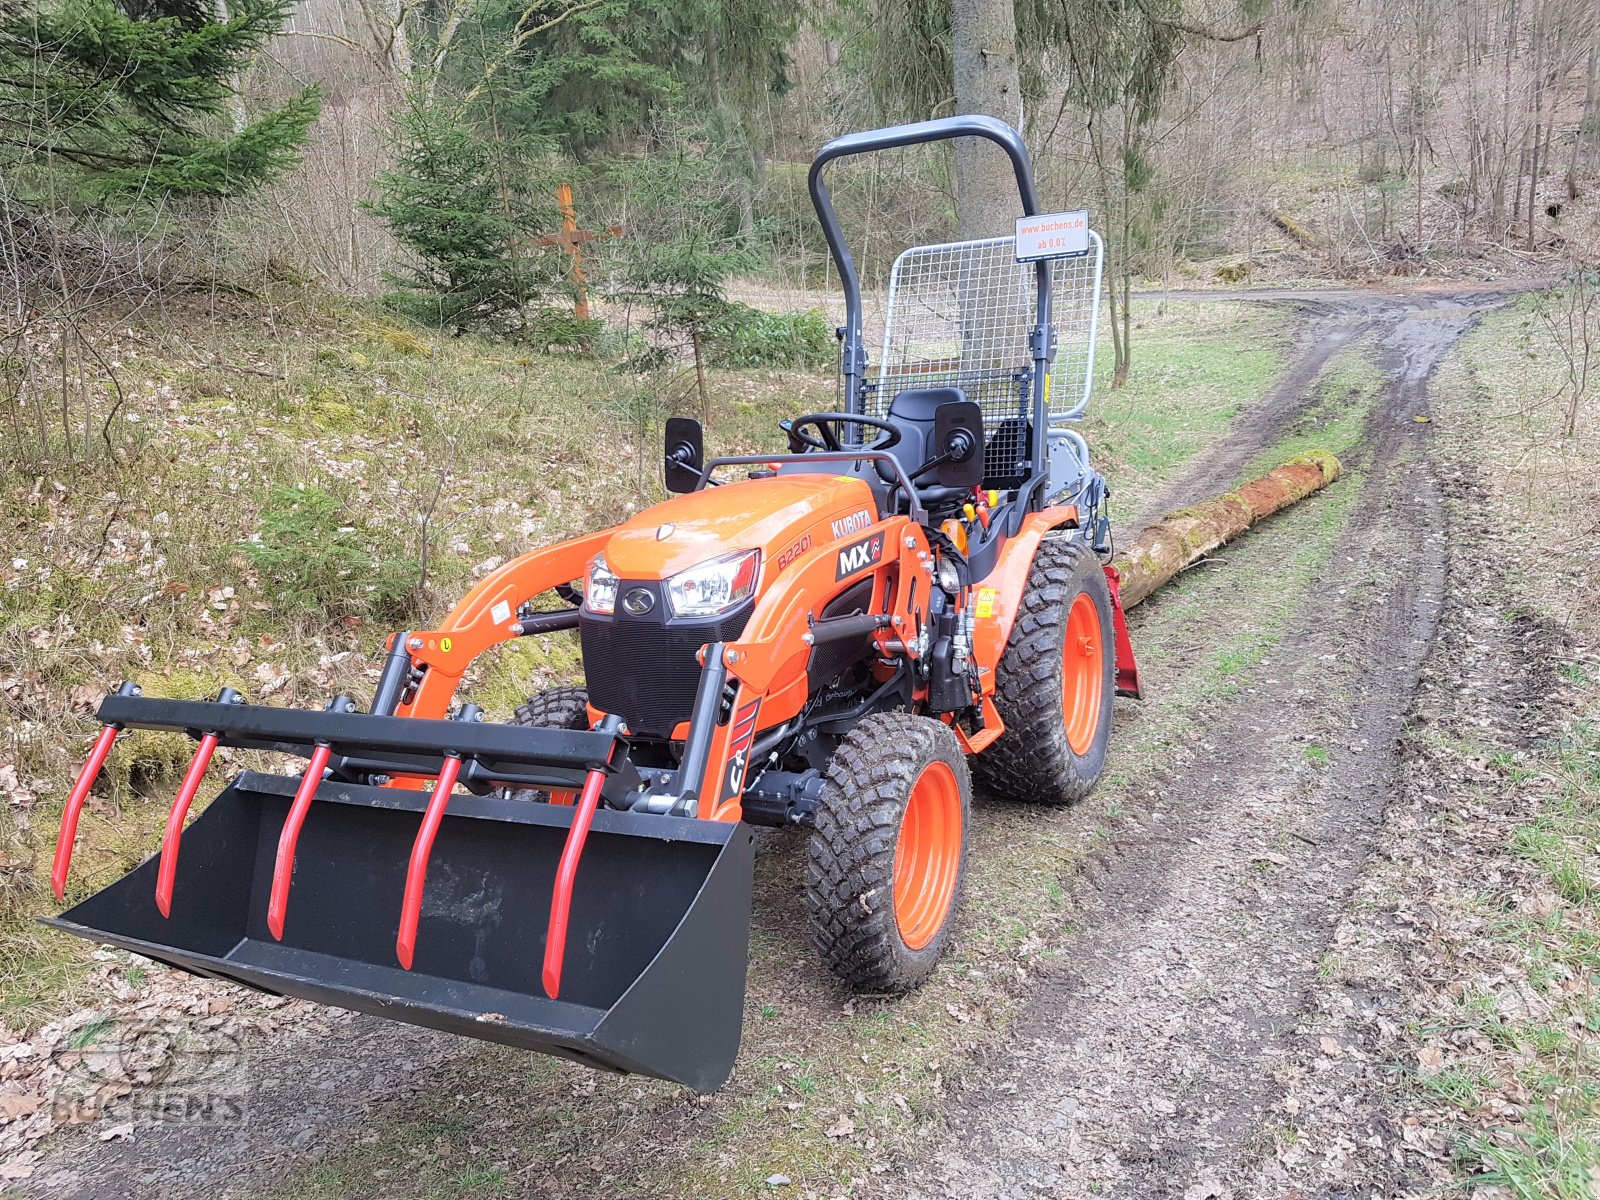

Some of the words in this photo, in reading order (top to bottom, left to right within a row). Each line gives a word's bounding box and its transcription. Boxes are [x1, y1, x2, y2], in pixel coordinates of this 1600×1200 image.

[1021, 218, 1083, 235] www.buchens.de
[1037, 240, 1047, 249] ab
[831, 509, 872, 540] KUBOTA
[777, 534, 812, 572] B2201
[840, 541, 871, 575] MX
